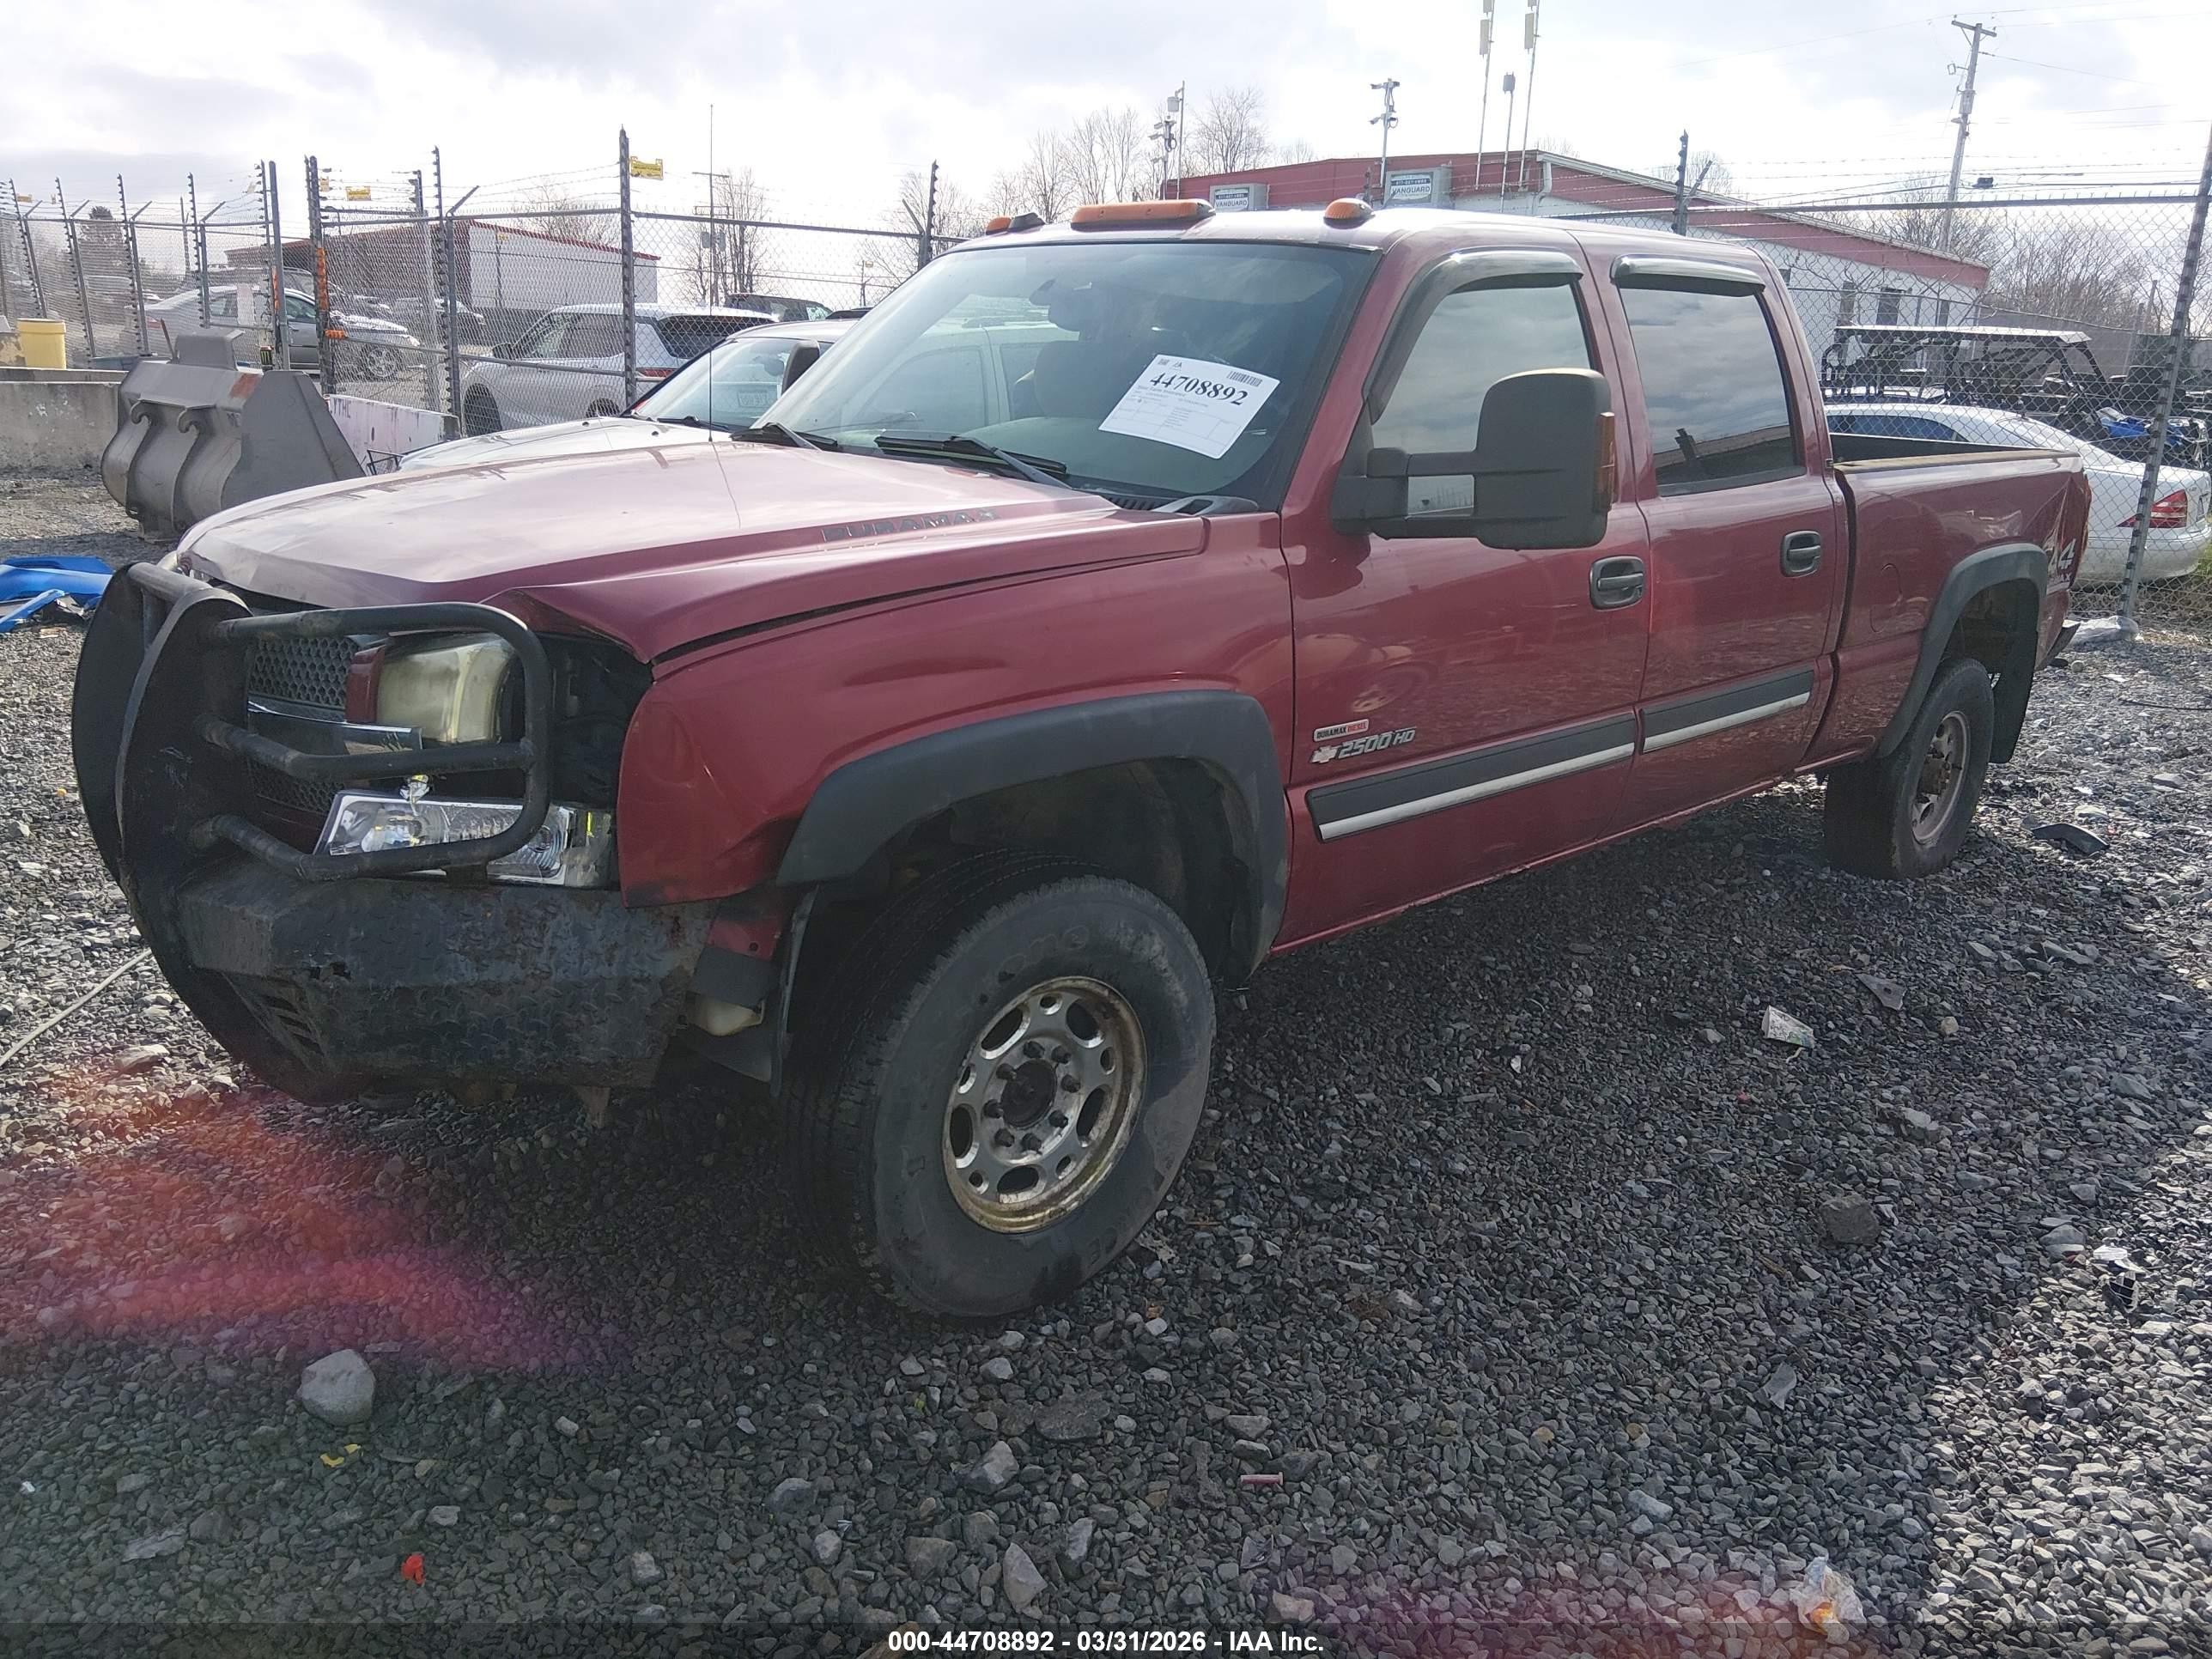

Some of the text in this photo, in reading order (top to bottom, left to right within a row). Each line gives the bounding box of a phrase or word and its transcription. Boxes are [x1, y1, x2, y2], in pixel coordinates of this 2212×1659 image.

[1150, 372, 1249, 405] 44708892
[1316, 726, 1347, 738] DURAMAX
[1338, 729, 1416, 758] 2500 HD
